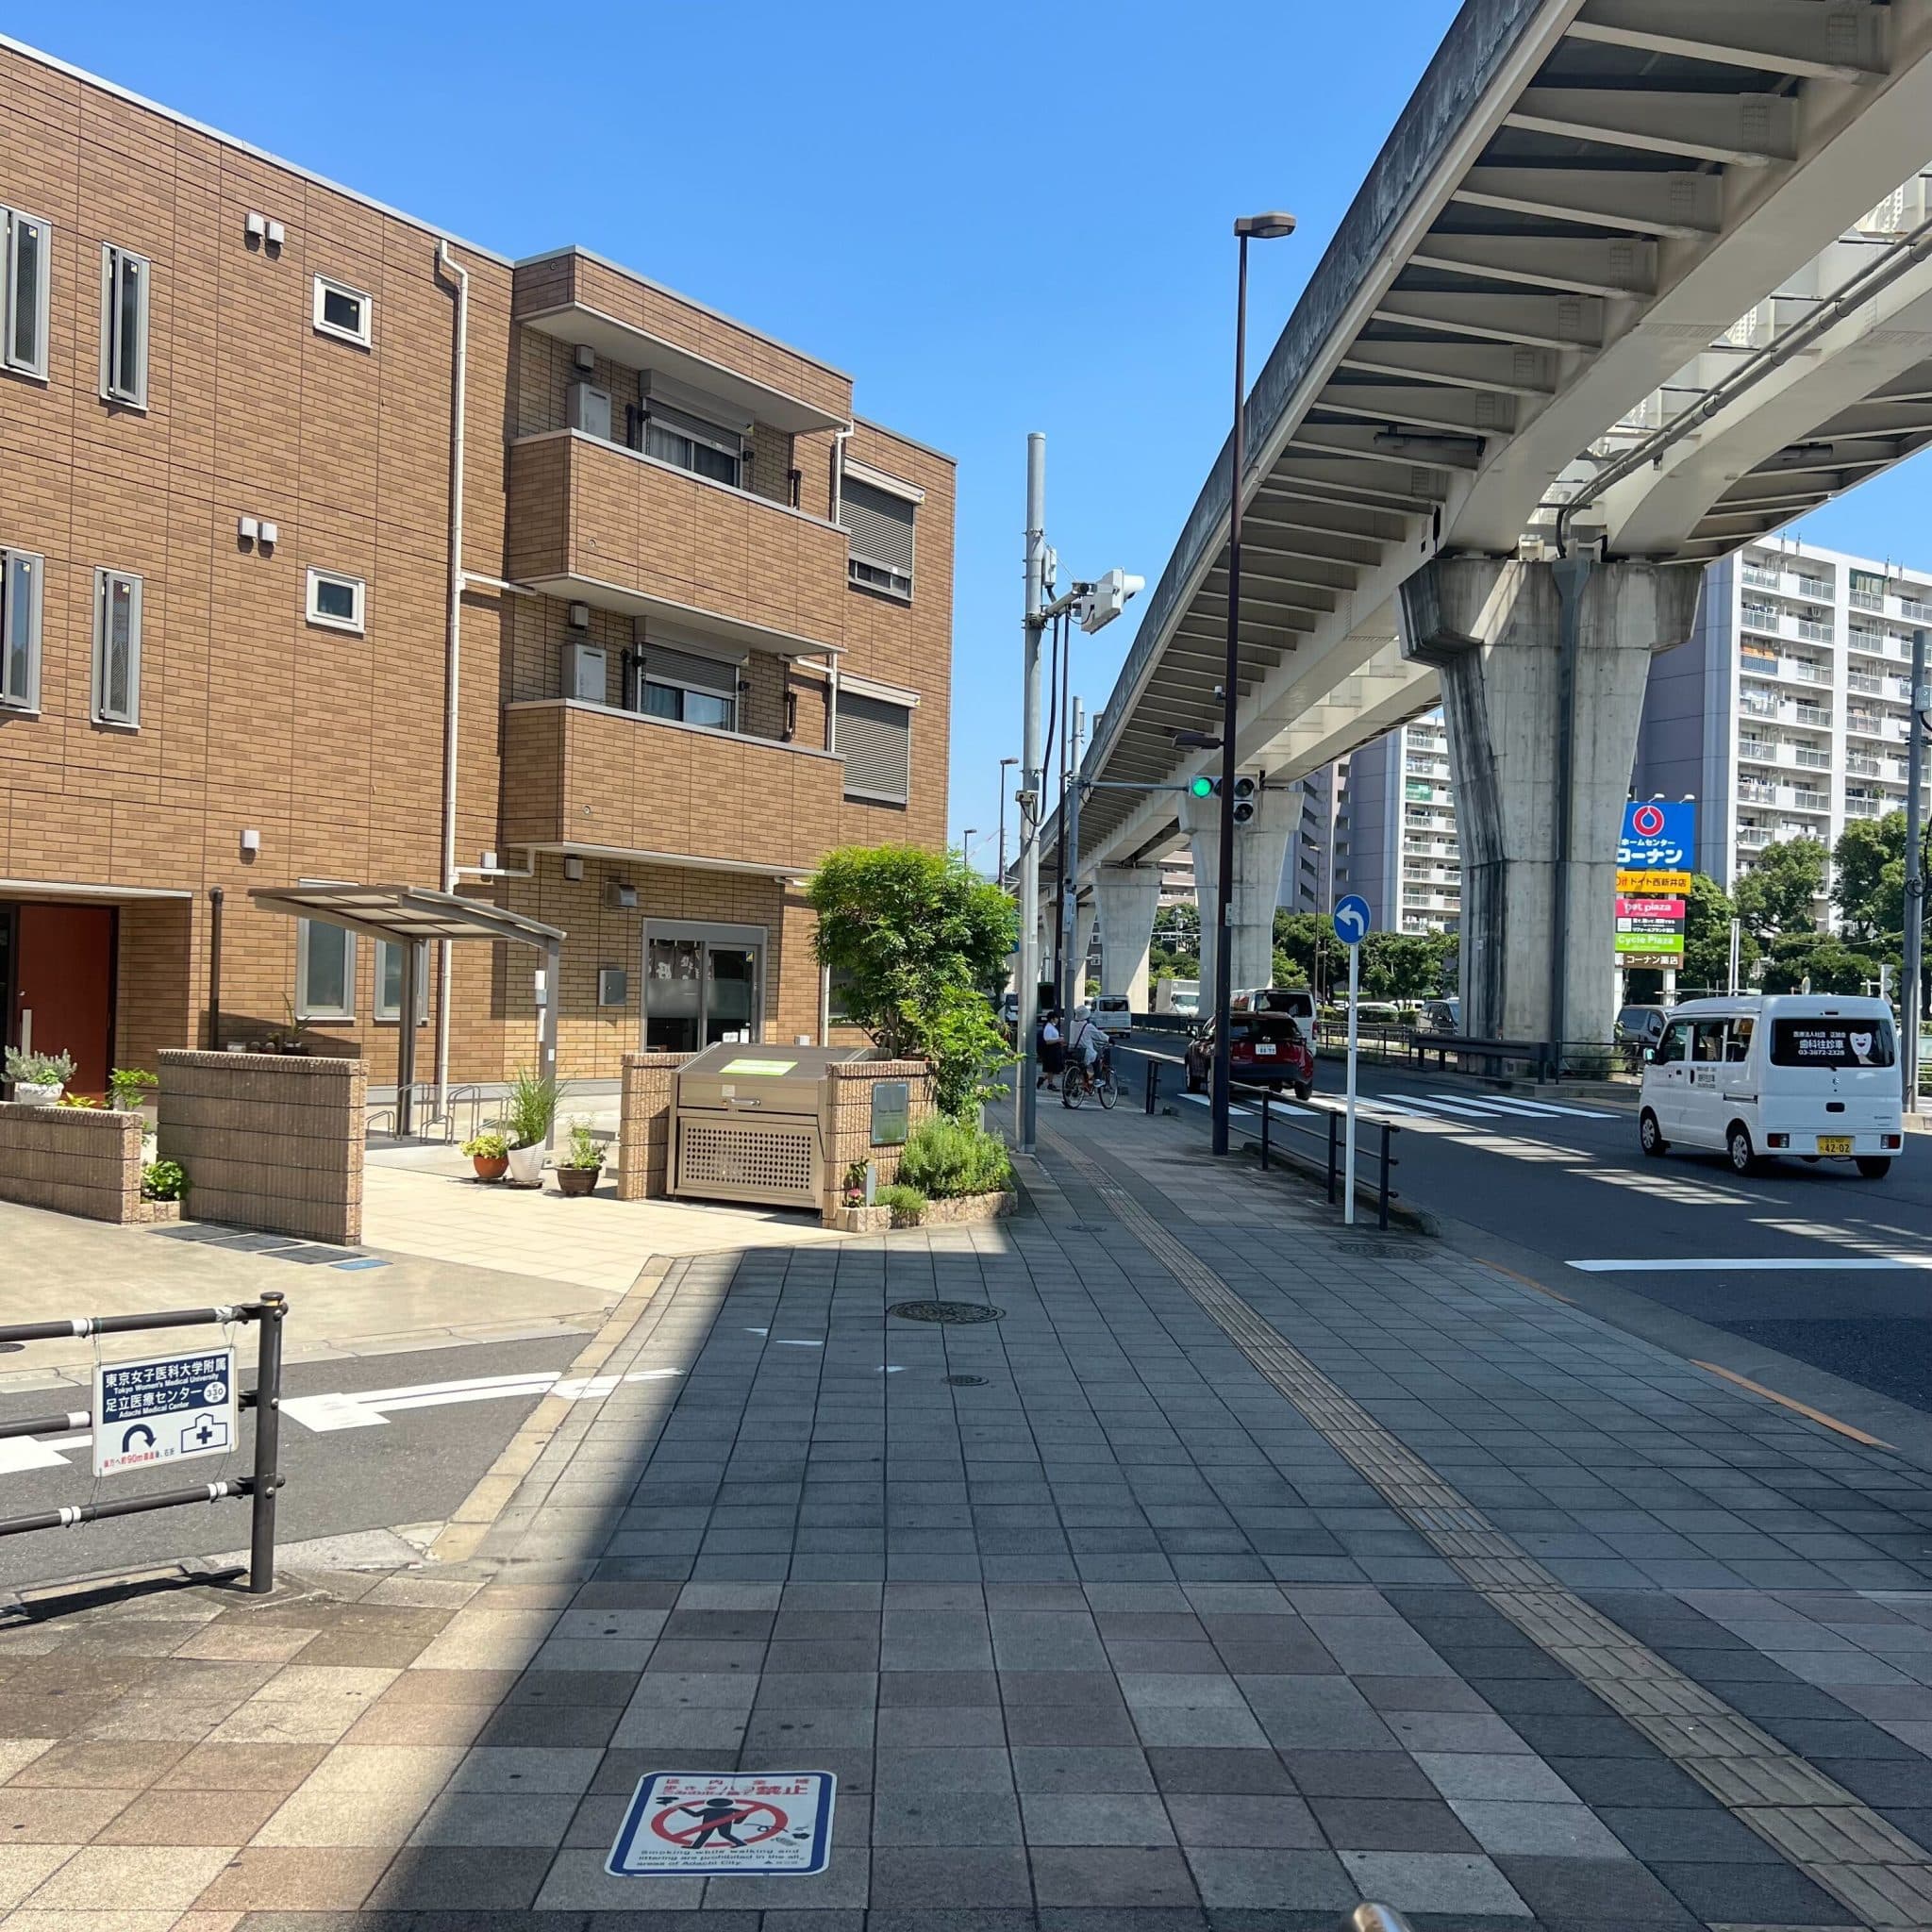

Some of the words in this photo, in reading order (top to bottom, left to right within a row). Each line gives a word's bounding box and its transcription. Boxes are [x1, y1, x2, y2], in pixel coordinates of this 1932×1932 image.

[1621, 838, 1676, 847] ホームセンター
[1616, 847, 1683, 864] コーナン
[1630, 877, 1687, 888] ドイト西新井店
[1644, 902, 1673, 912] plaza
[1618, 935, 1646, 946] Cycle
[1647, 935, 1674, 945] Plaza
[105, 1357, 226, 1388] 東京女子医科大学附属
[105, 1386, 203, 1413] 足立医療センター
